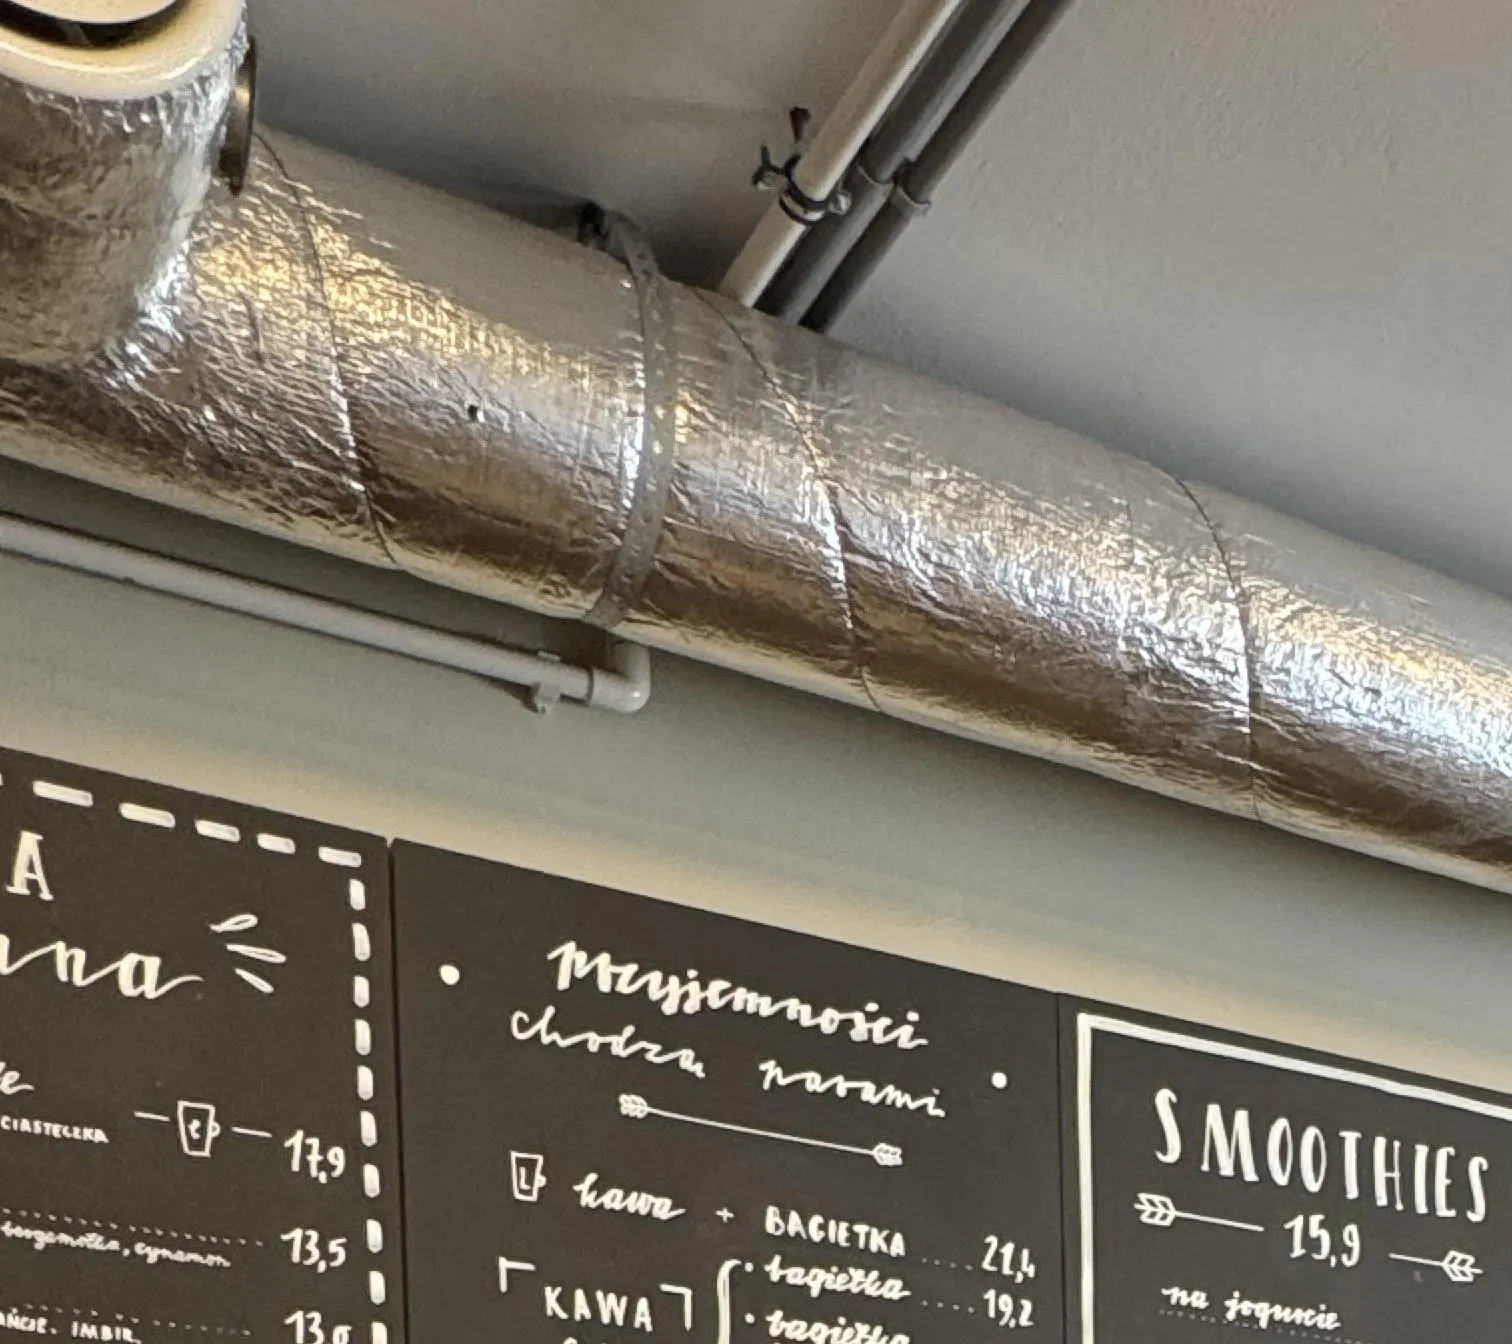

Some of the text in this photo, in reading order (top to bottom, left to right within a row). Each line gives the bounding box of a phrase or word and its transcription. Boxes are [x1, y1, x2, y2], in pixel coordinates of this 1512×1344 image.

[758, 1059, 946, 1118] parami
[283, 1129, 346, 1184] 17,9
[1154, 1088, 1489, 1223] SMOOTHIES
[572, 1172, 686, 1220] kawa
[764, 1205, 906, 1258] BAGIETKA
[1284, 1214, 1361, 1268] 15,9
[280, 1227, 347, 1274] 13,5
[981, 1234, 1036, 1284] 21,4
[763, 1254, 912, 1300] bagietka
[544, 1286, 653, 1332] KAWA
[1161, 1286, 1341, 1330] na jogurcie
